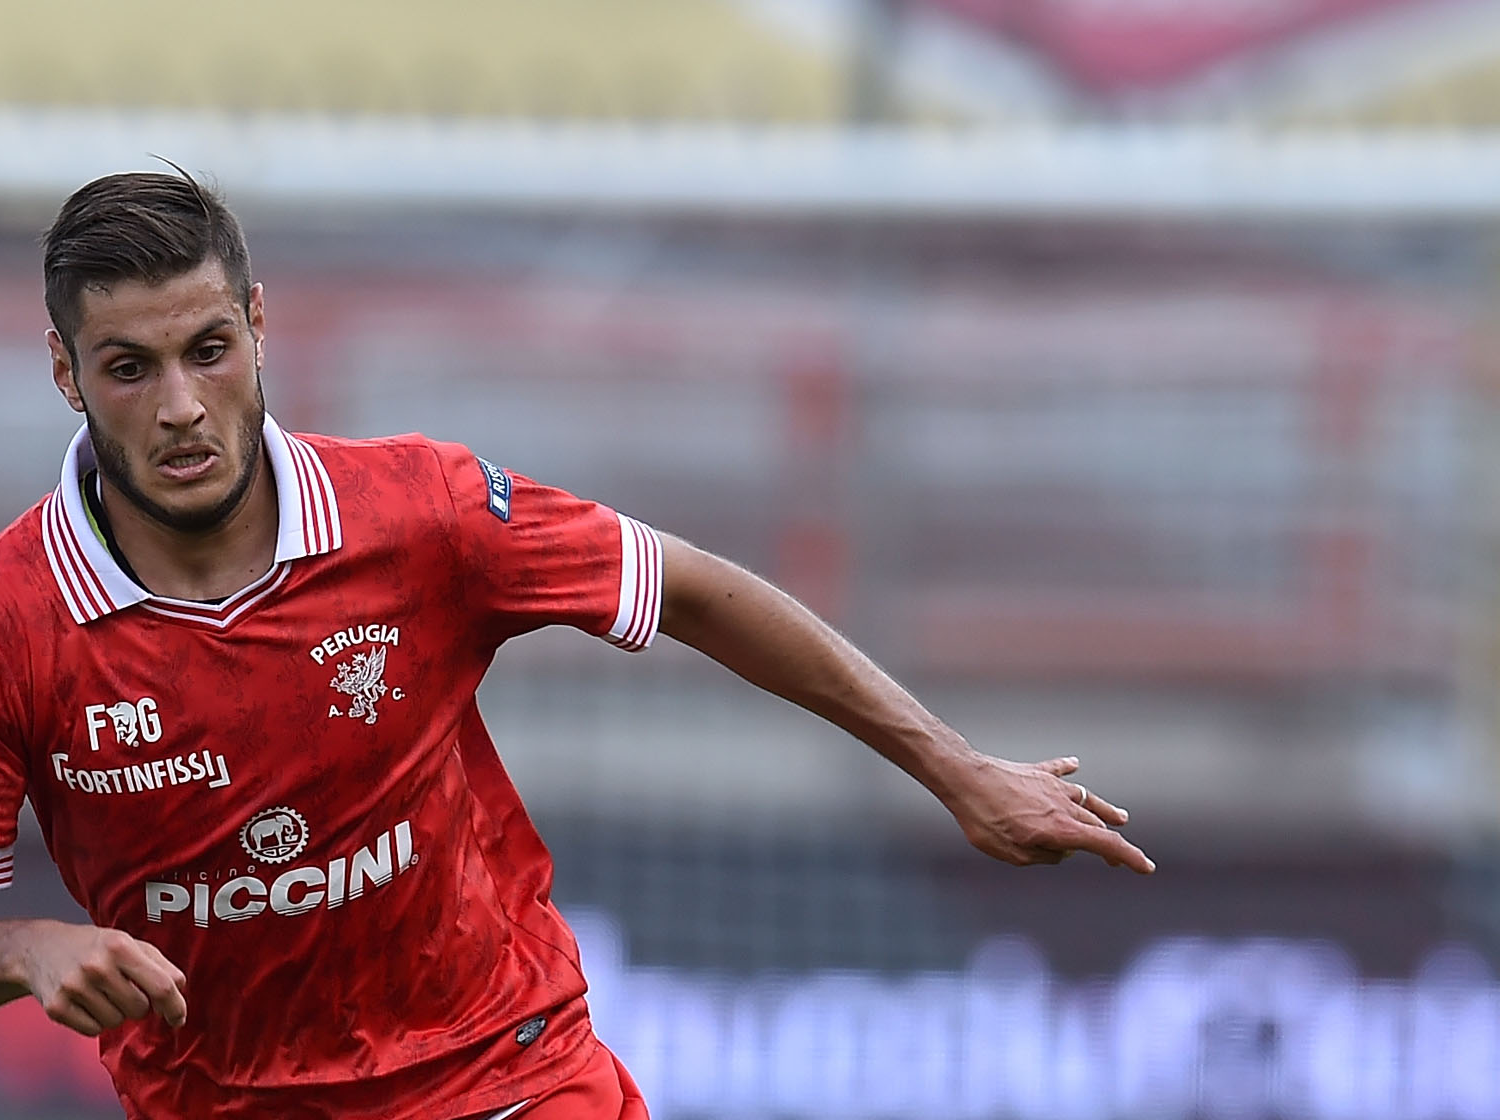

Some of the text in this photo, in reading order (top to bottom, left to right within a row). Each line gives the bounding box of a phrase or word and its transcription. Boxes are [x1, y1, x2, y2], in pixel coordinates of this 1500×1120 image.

[310, 624, 399, 665] PERUGIA
[63, 749, 216, 794] FORTINFISSI
[145, 819, 412, 928] PICCINI
